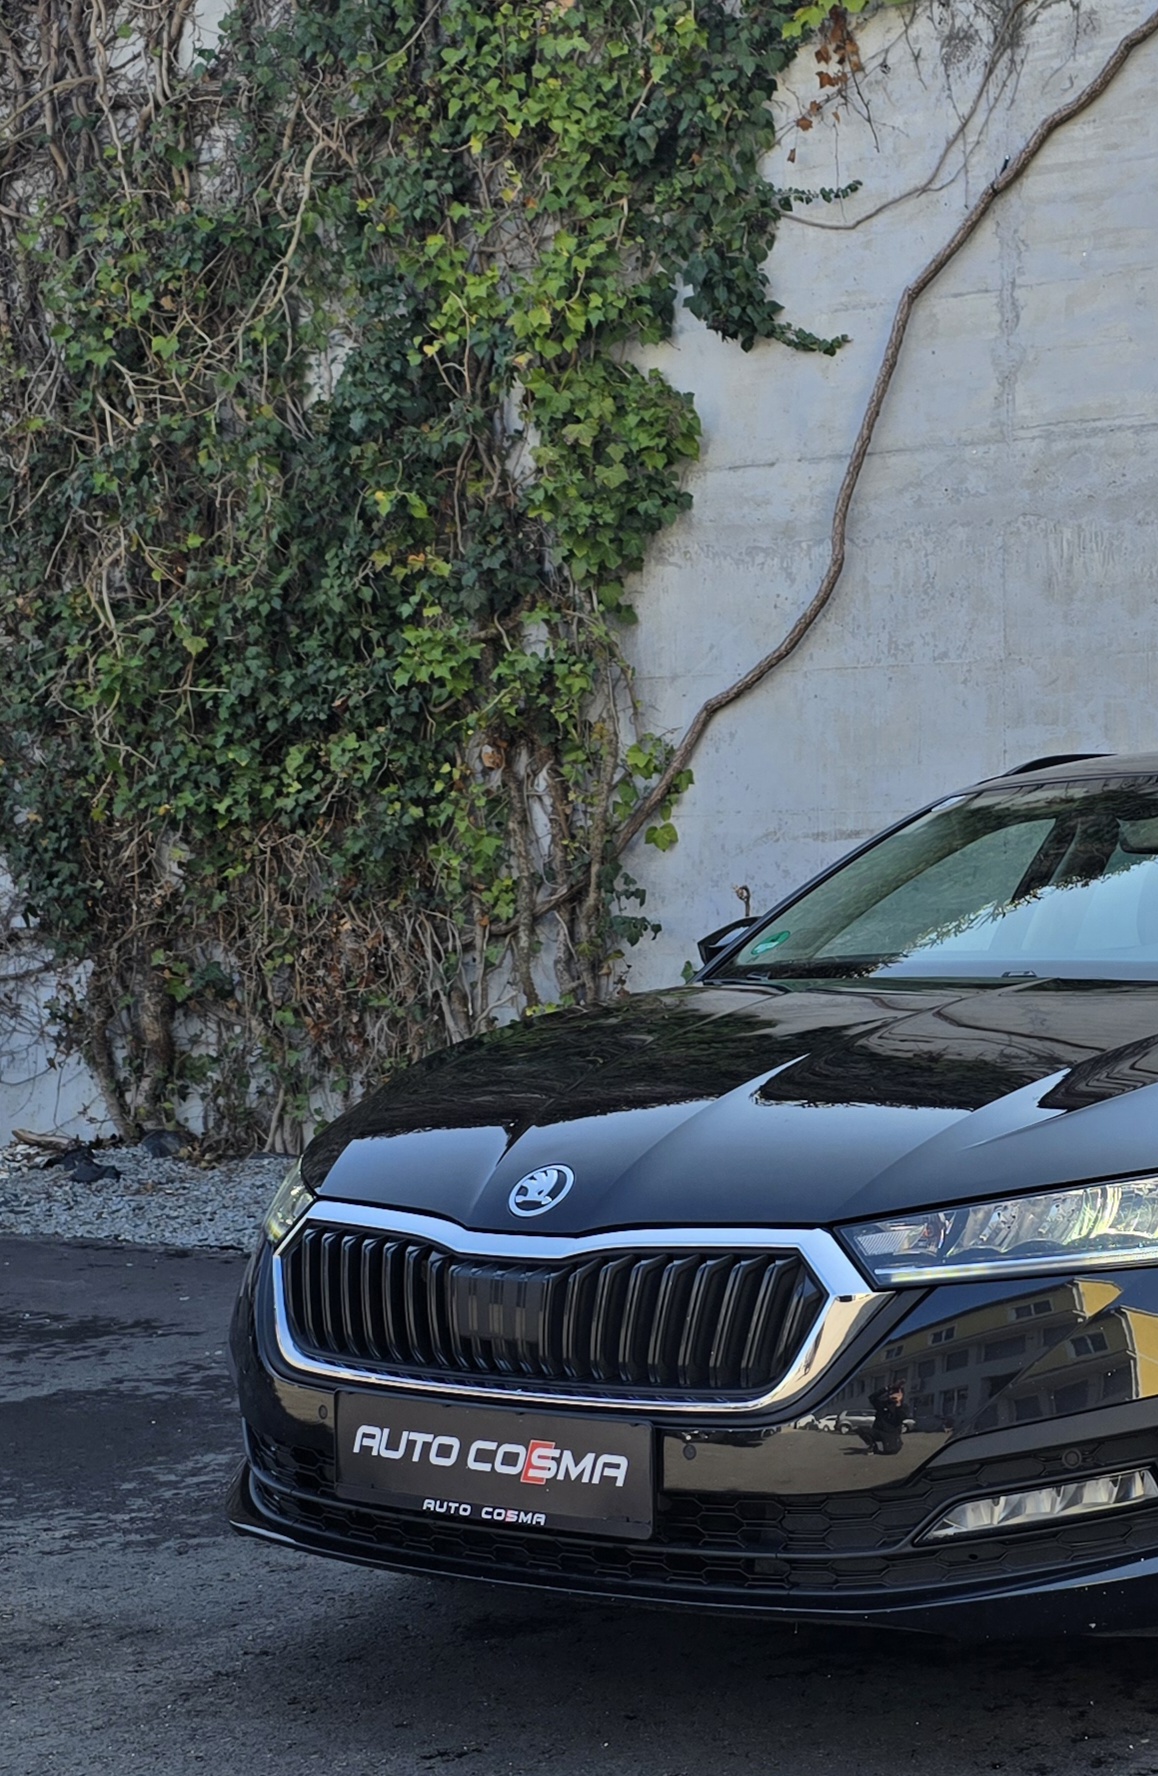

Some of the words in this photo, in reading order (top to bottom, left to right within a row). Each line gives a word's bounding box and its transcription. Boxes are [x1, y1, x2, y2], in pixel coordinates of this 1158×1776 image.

[353, 1424, 460, 1467] AUTO
[467, 1440, 629, 1487] COSMA
[422, 1498, 472, 1516] AUTO
[481, 1507, 547, 1526] COSMA
